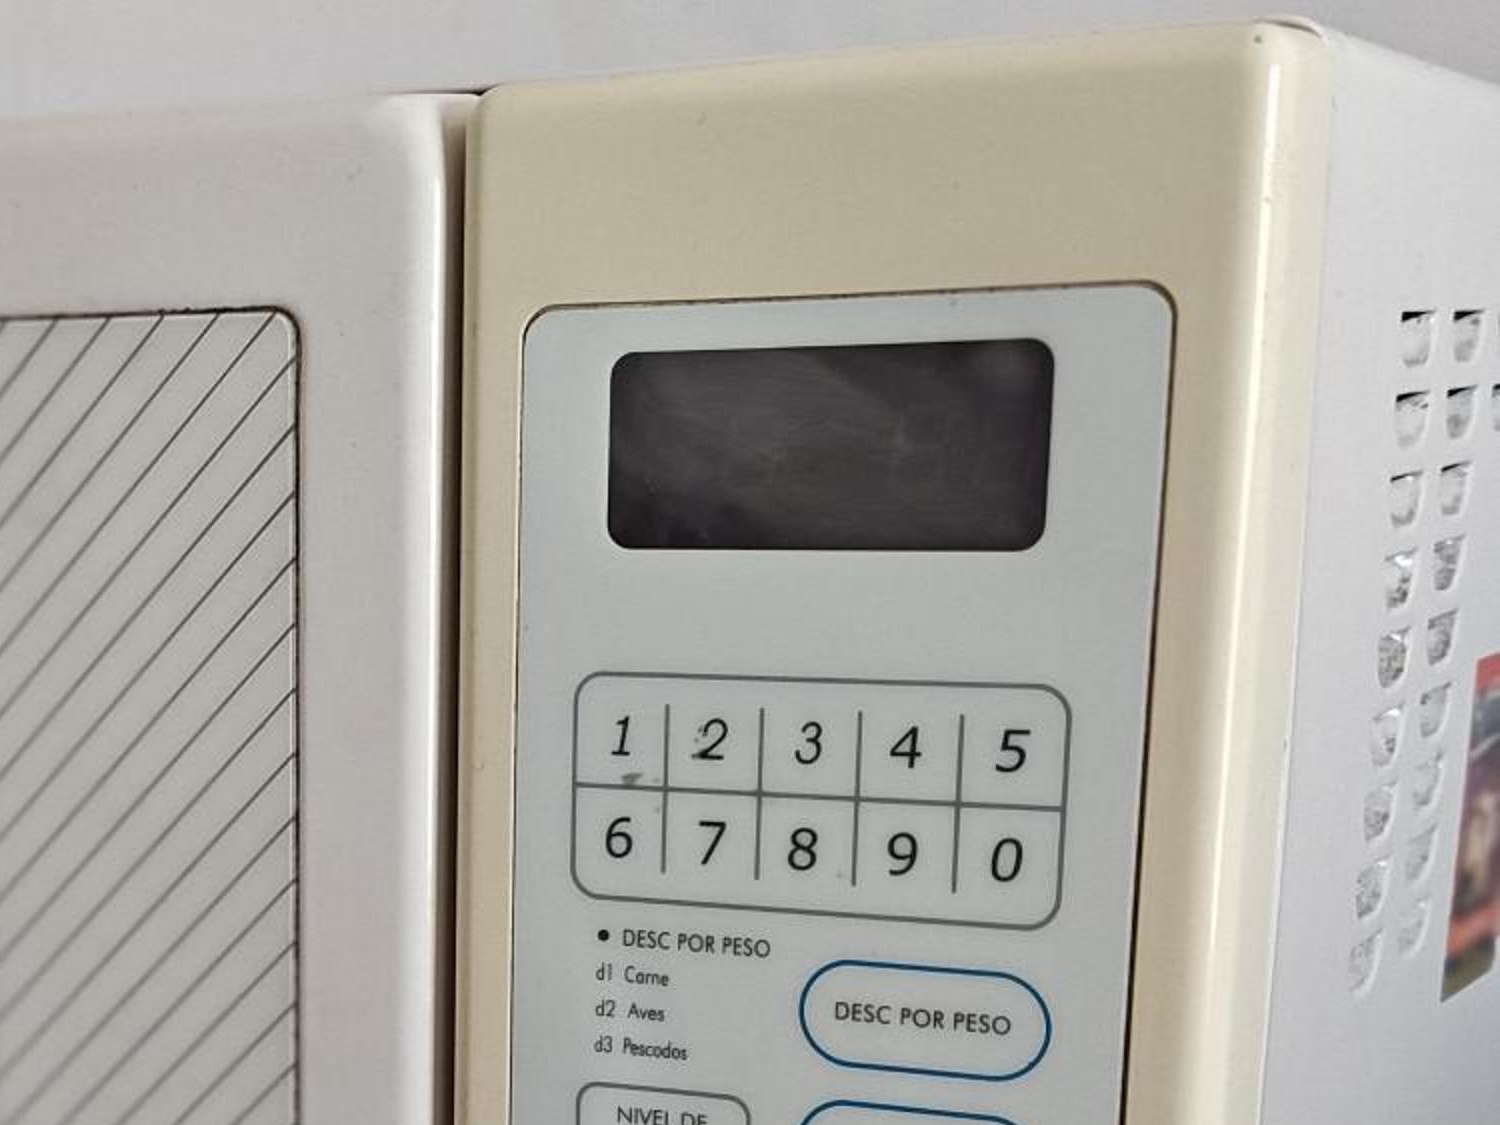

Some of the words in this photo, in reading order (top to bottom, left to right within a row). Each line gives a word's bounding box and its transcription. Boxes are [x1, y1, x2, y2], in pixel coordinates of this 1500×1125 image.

[610, 716, 631, 757] 1
[694, 718, 729, 760] 2
[795, 721, 824, 764] 3
[890, 726, 922, 769] 4
[995, 729, 1031, 773] 5
[605, 817, 633, 858] 6
[698, 820, 727, 865] 7
[787, 827, 818, 870] 8
[887, 832, 918, 876] 9
[990, 837, 1023, 882] 0
[623, 929, 670, 951] DESC
[677, 933, 715, 954] POR
[721, 936, 771, 959] PESO
[595, 965, 613, 983] d1
[624, 966, 669, 988] Carne
[595, 1001, 615, 1019] d2
[628, 1002, 665, 1023] Aves
[834, 1002, 891, 1026] DESC
[900, 1007, 945, 1031] POR
[953, 1012, 1011, 1036] PESO
[594, 1035, 613, 1054] d3
